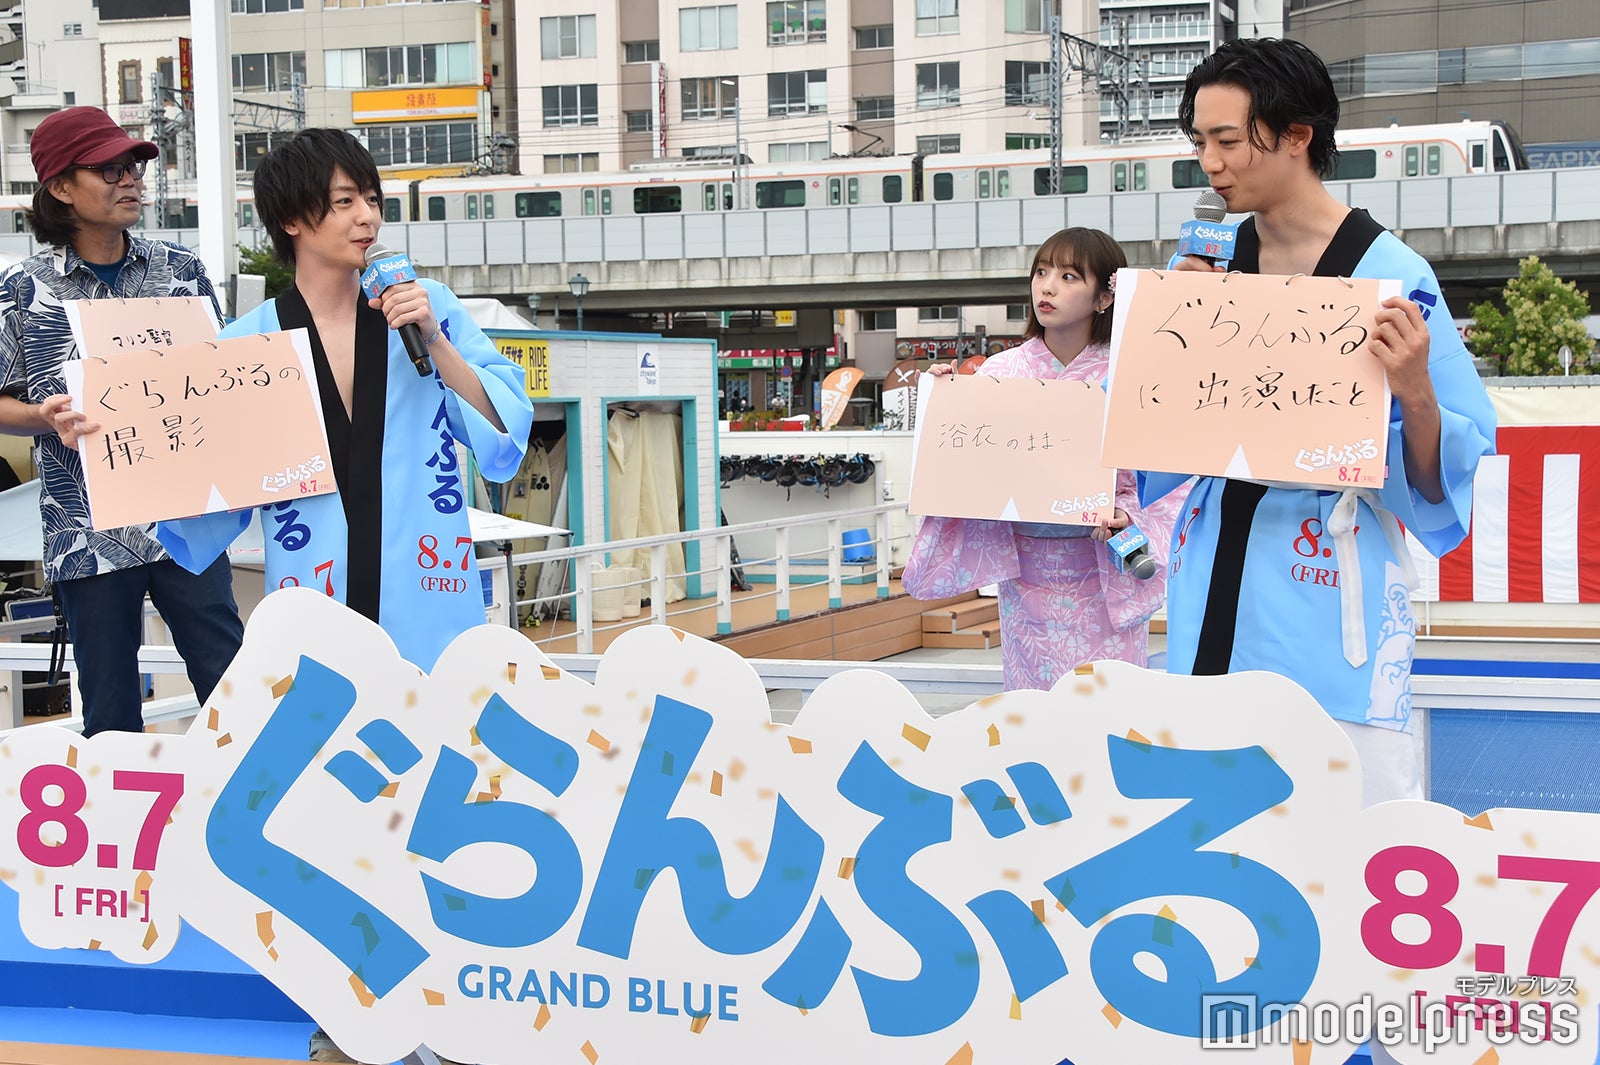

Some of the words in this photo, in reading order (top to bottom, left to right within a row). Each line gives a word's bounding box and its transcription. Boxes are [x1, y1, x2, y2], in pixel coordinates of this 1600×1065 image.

[1527, 150, 1600, 169] SAPIX
[112, 328, 173, 347] マリン監督
[1153, 298, 1368, 355] ぐらんぶる
[529, 346, 547, 368] RIDE
[99, 363, 301, 412] ぐらんぶるの
[530, 369, 548, 390] LIFE
[101, 414, 205, 471] 撮影
[1294, 438, 1379, 473] ぐらんぶる
[262, 454, 327, 493] ぐらんぶる
[299, 480, 317, 494] 8.7
[1338, 466, 1361, 482] 8.7
[1050, 491, 1110, 517] ぐらんぶる
[1081, 512, 1098, 523] 8.7
[416, 534, 473, 572] 8.7
[420, 575, 467, 594] (FRI)
[17, 764, 185, 871] 8.7
[205, 653, 1322, 1039] ぐらんぶる
[1360, 845, 1600, 979] 8.7
[457, 963, 611, 1009] GRAND
[628, 976, 740, 1022] BLUE
